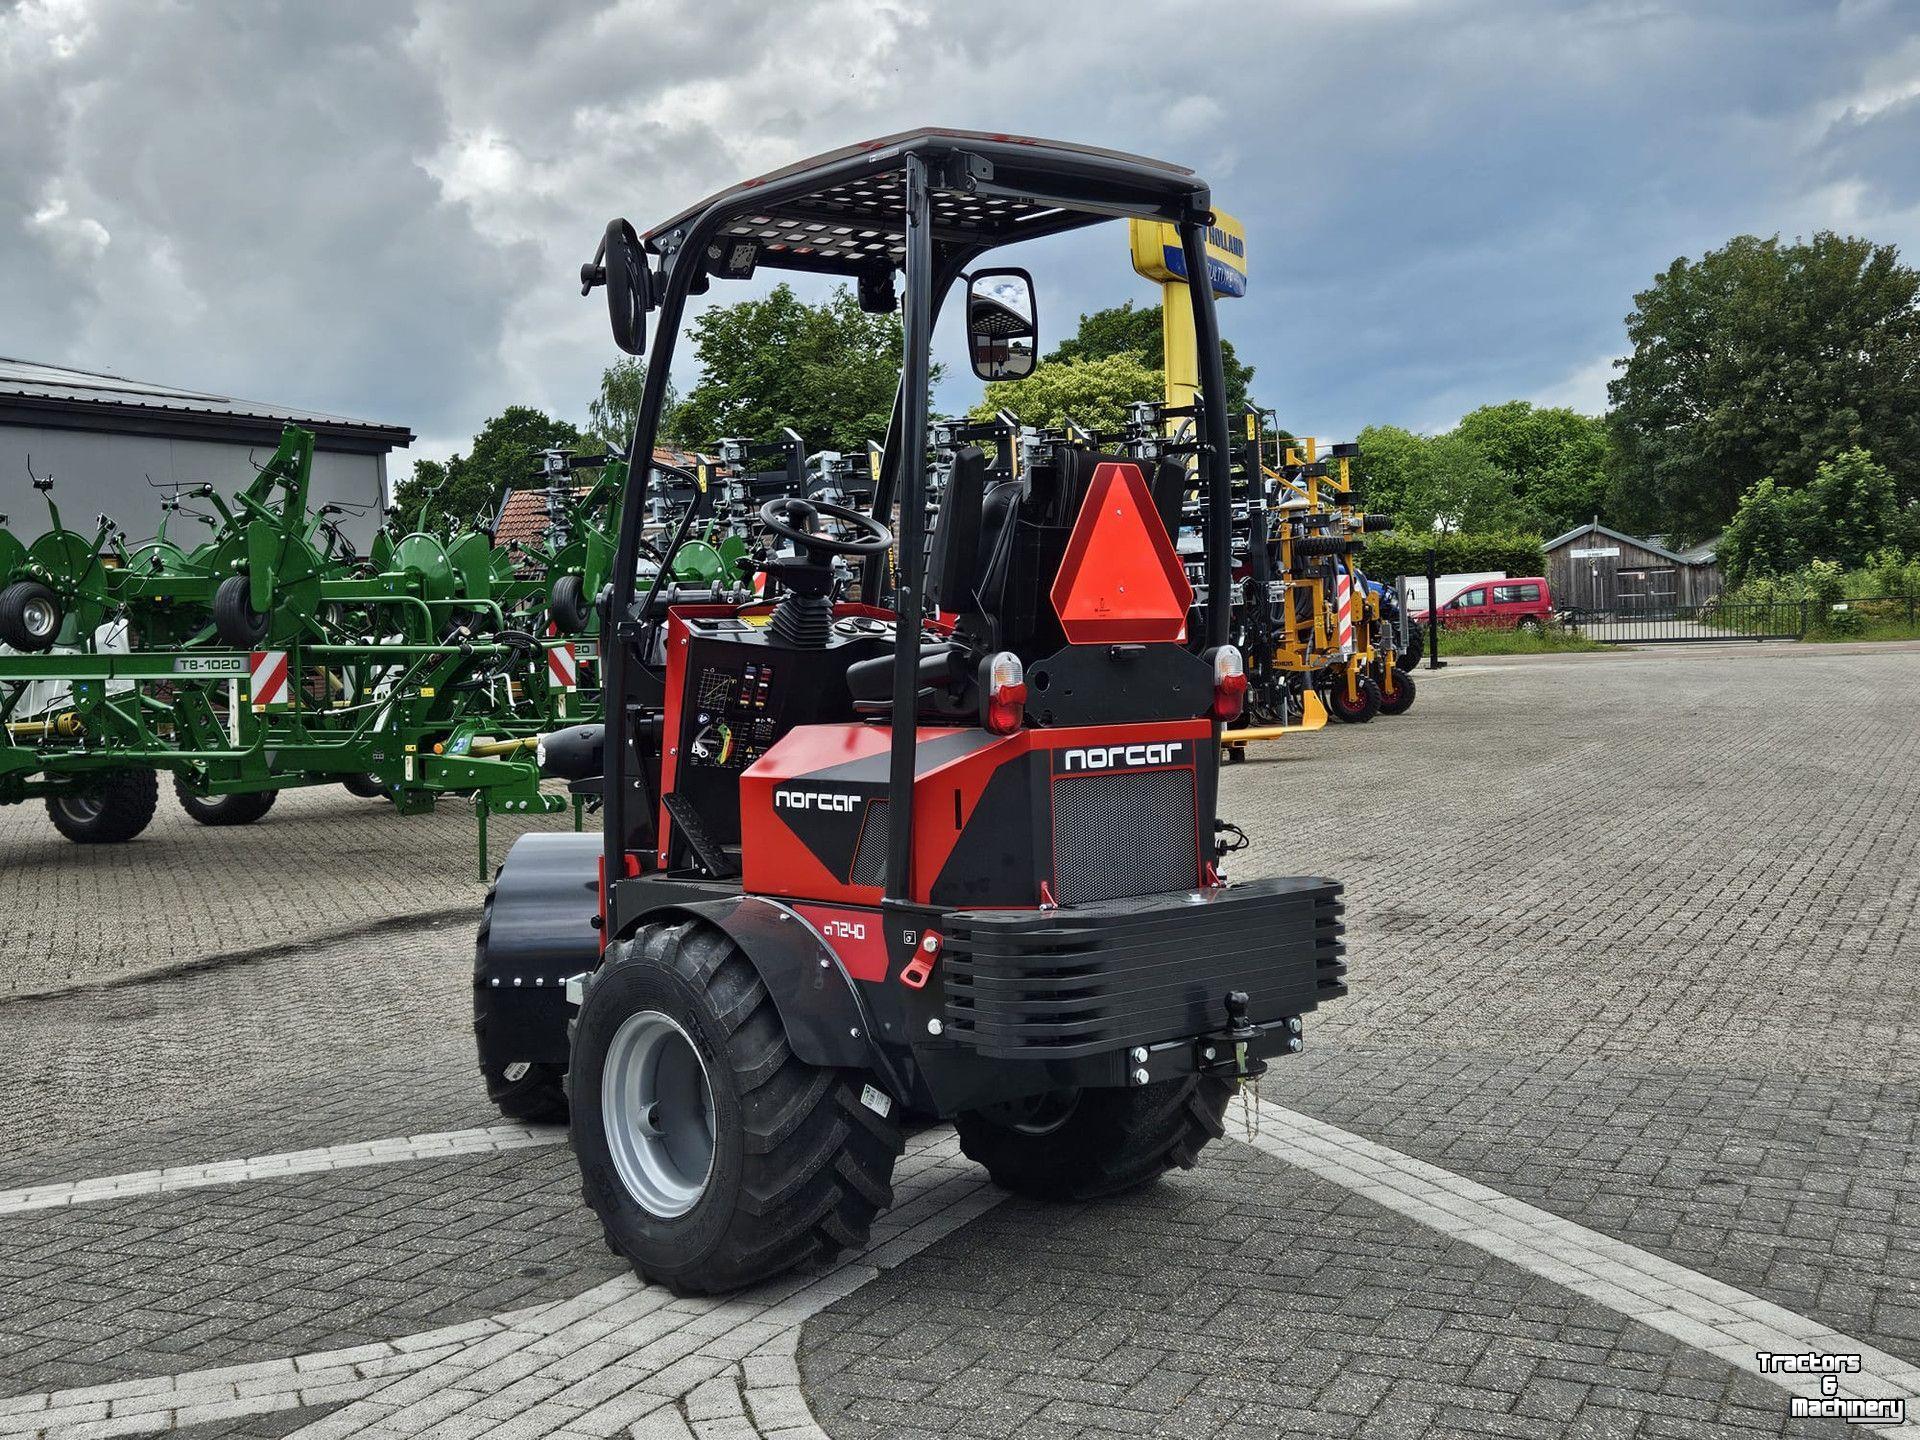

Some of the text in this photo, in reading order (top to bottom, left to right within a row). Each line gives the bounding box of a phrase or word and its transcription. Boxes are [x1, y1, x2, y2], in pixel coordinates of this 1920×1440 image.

[1209, 226, 1244, 258] HOLLAND
[1065, 743, 1182, 770] norcar
[775, 790, 861, 812] norcar
